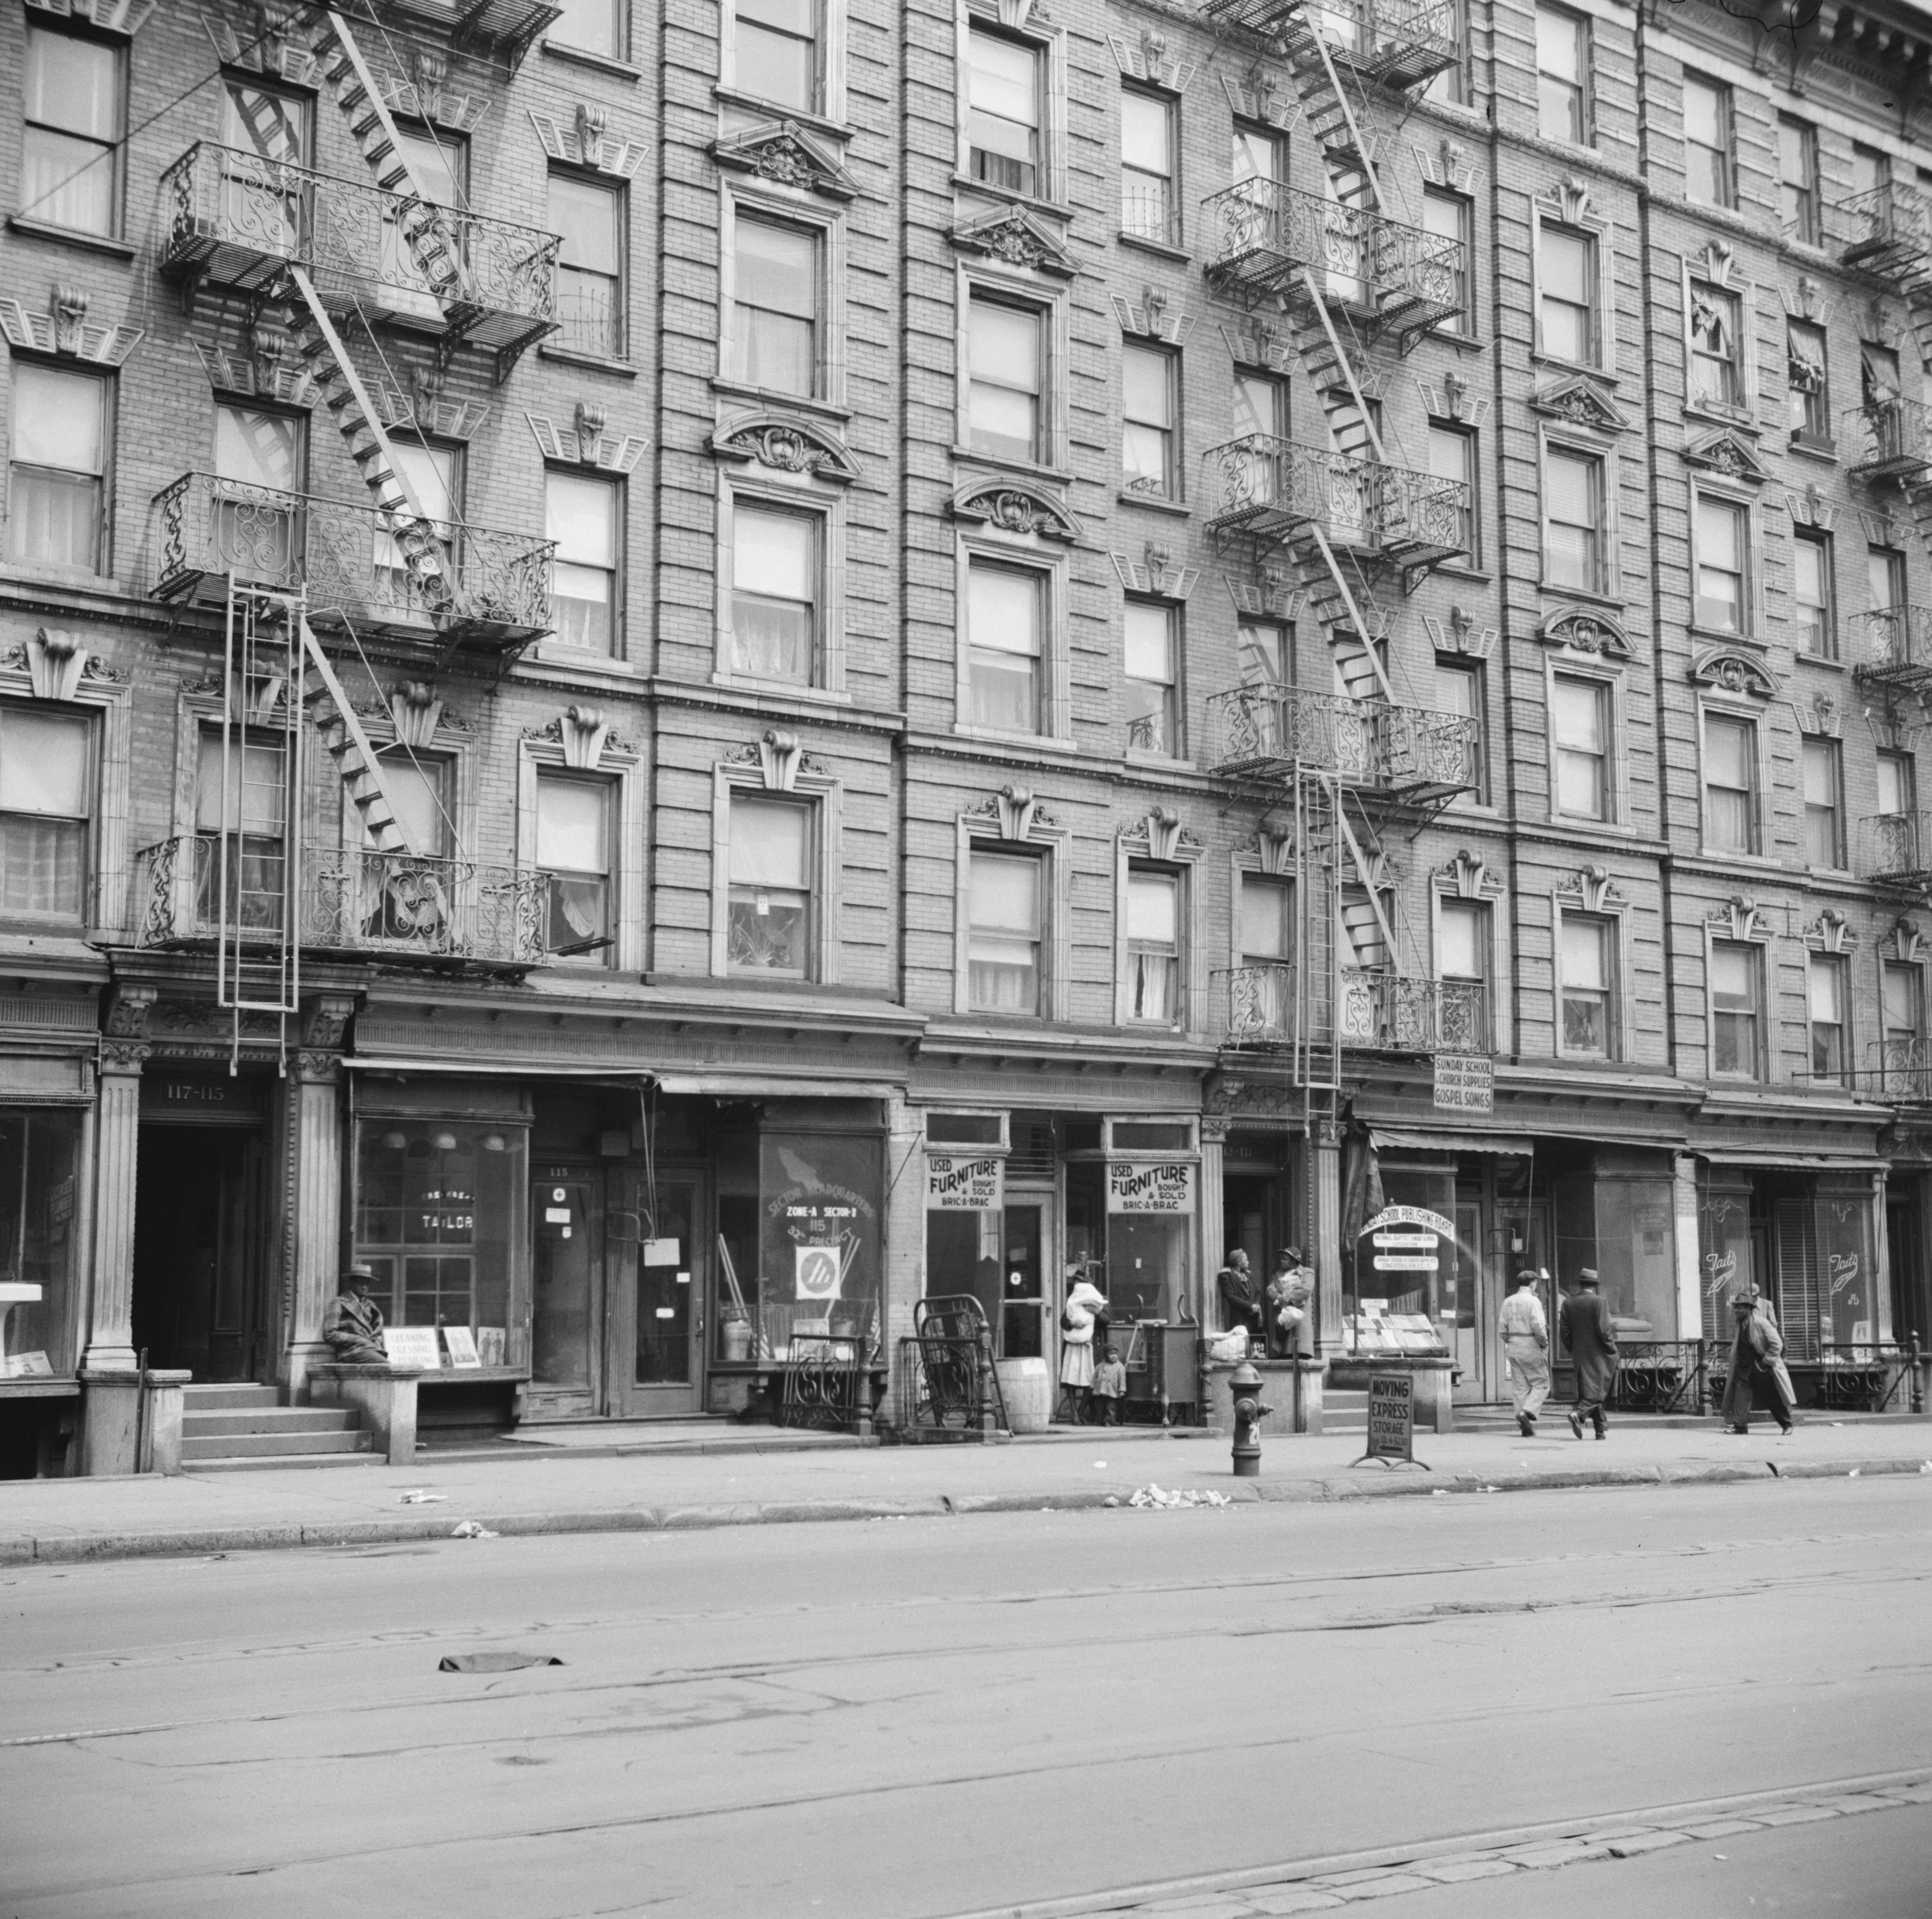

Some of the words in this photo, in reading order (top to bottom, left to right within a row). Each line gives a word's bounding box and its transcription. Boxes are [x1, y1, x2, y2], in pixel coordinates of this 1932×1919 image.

[1436, 1058, 1464, 1072] SUNDAY
[1465, 1061, 1490, 1074] SCHOOL
[1439, 1073, 1462, 1086] CHURCH
[1463, 1075, 1491, 1088] SUPPLIES
[168, 1086, 223, 1100] 117-115
[1435, 1088, 1462, 1105] GOSPEL
[1464, 1091, 1490, 1108] SONGS
[551, 1168, 567, 1176] 115
[930, 1159, 952, 1172] USED
[1111, 1165, 1132, 1177] USED
[930, 1160, 997, 1194] FURNITURE
[1111, 1166, 1188, 1196] FURNITURE
[768, 1187, 802, 1217] SECTOR
[1123, 1201, 1178, 1210] BRIC-A-BRAC
[422, 1215, 473, 1228] TAILOR
[1381, 1208, 1400, 1223] SCHOOL
[1402, 1208, 1434, 1226] PUBLISHING
[1435, 1215, 1452, 1237] BOARD
[809, 1227, 852, 1247] PRECINCT
[1706, 1249, 1736, 1271] Tait's
[1830, 1251, 1858, 1272] Tait's
[1372, 1379, 1409, 1398] MOVING
[1372, 1401, 1408, 1420] EXPRESS
[1373, 1421, 1404, 1435] STORAGE
